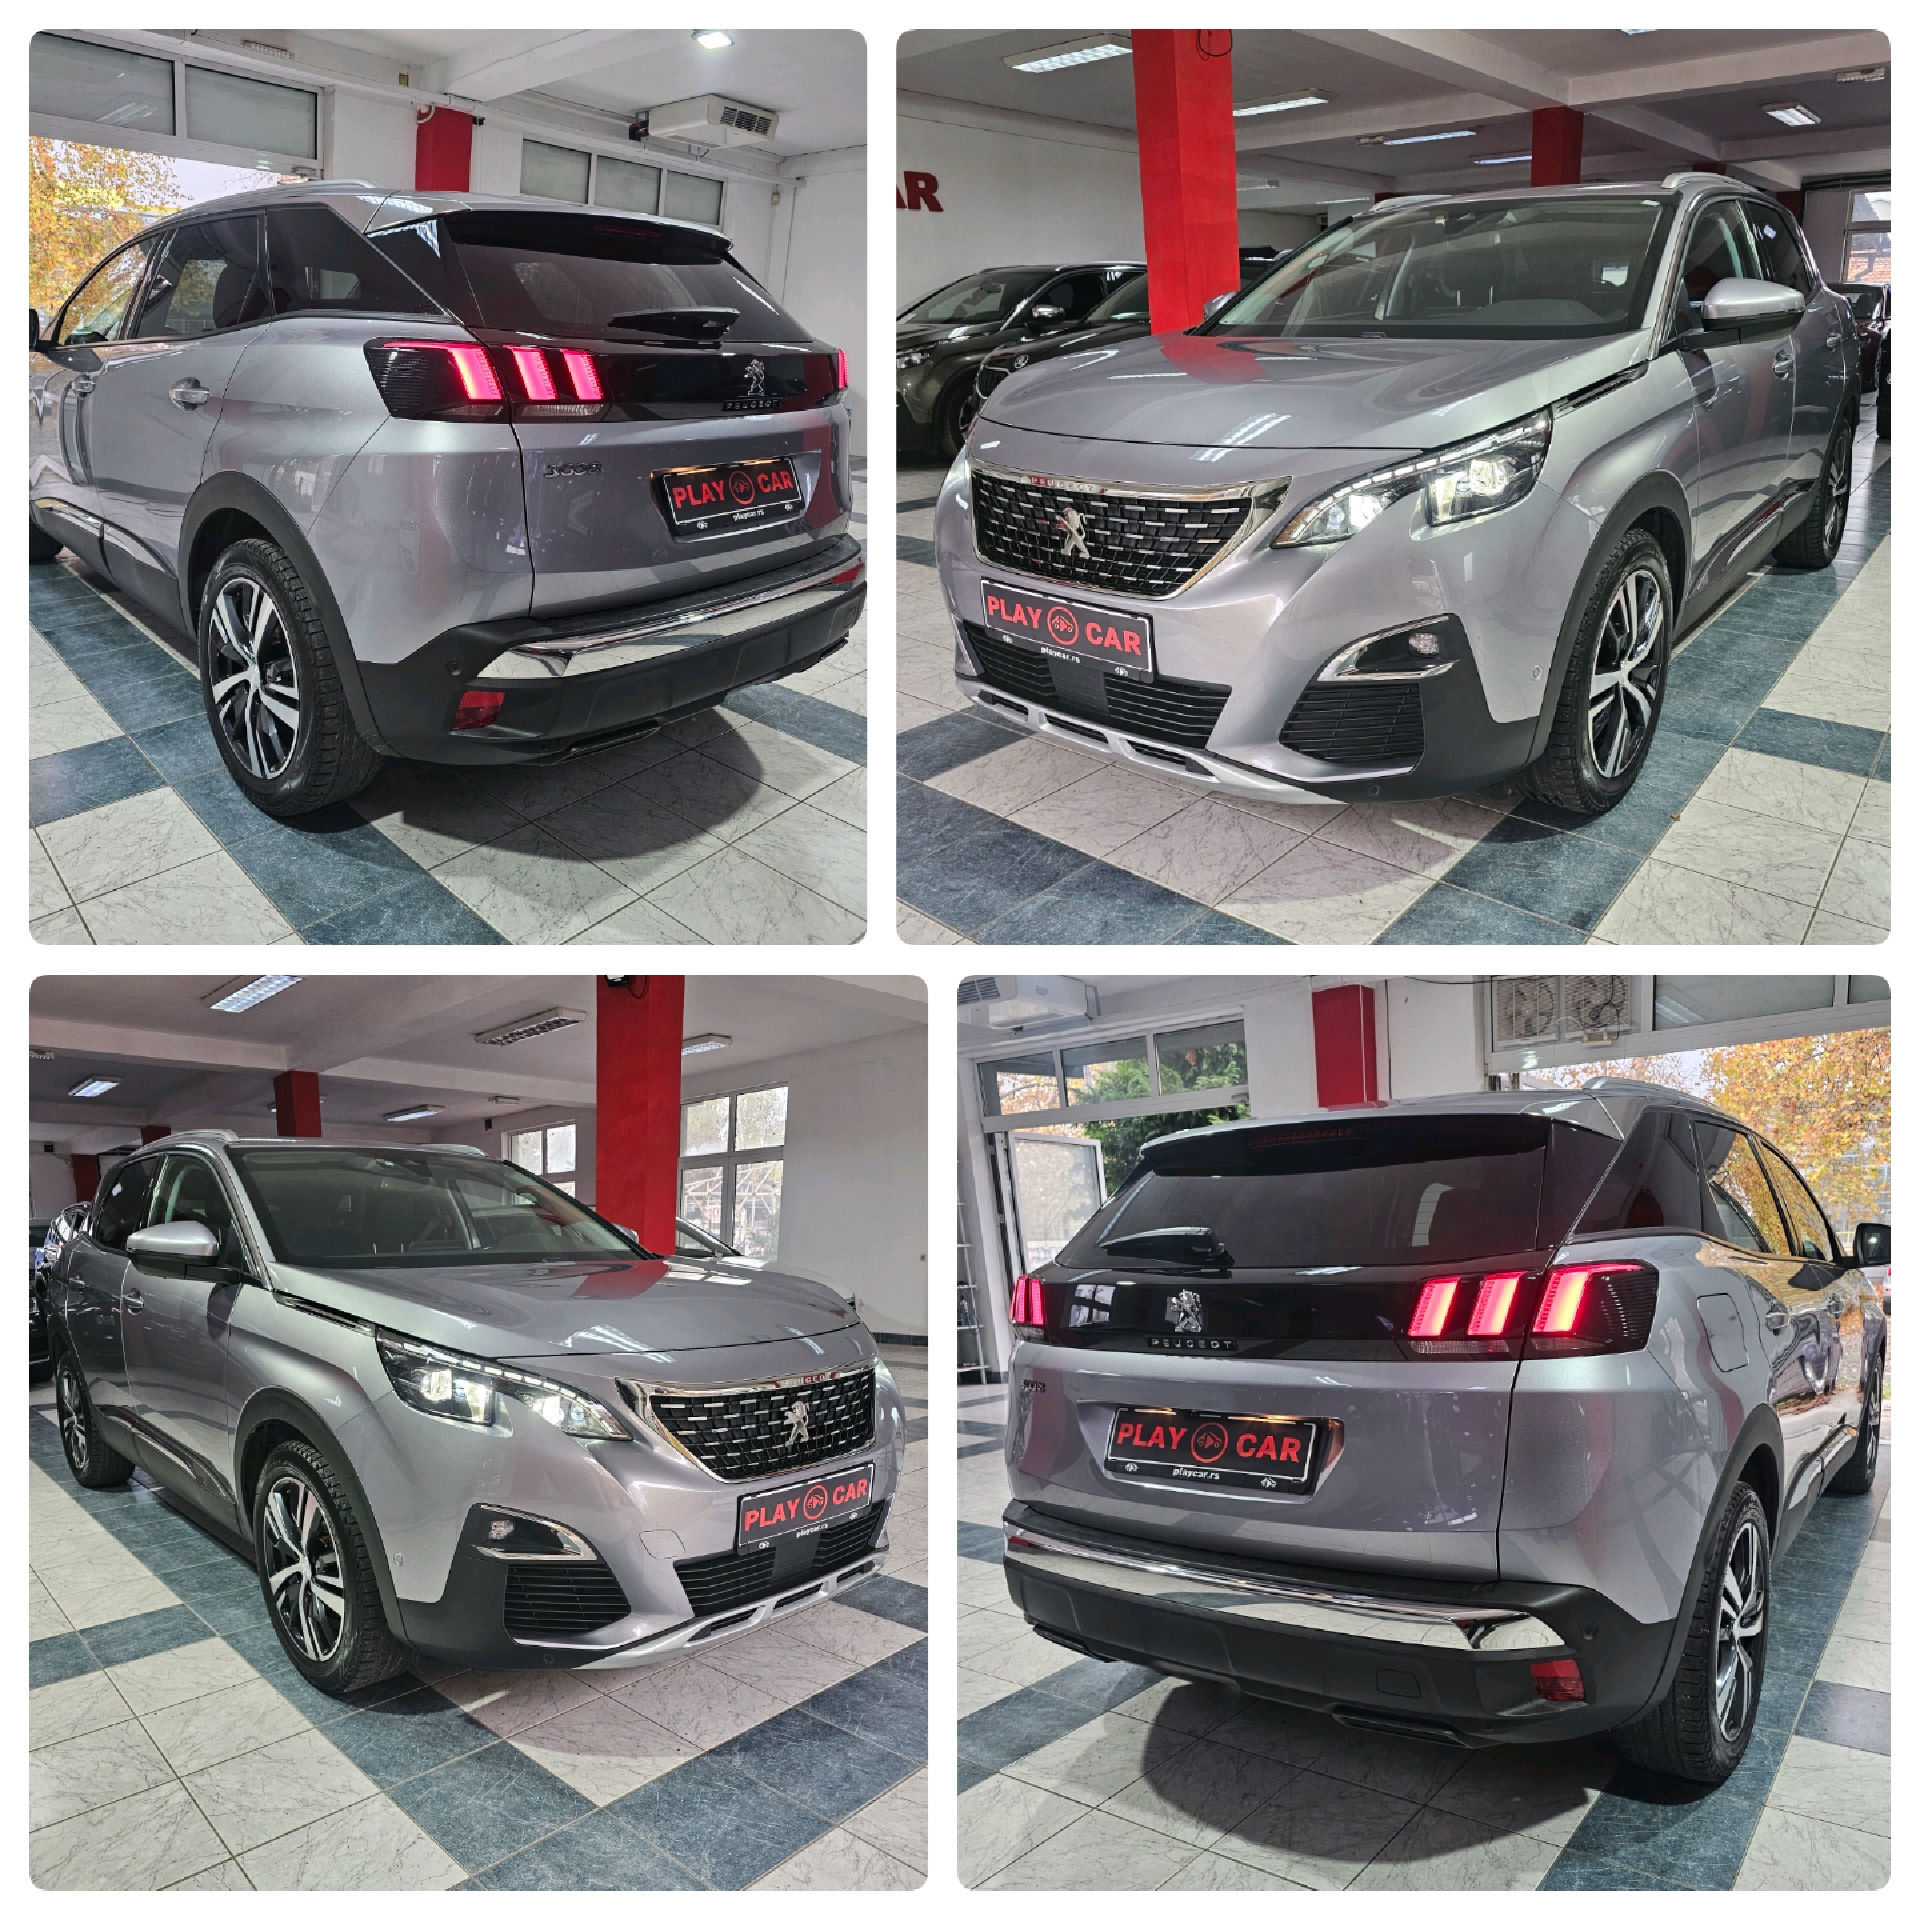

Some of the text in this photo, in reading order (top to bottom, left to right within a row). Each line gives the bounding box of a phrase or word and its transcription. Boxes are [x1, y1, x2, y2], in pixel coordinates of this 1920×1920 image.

[672, 471, 794, 508] PLAY CAR
[986, 595, 1142, 656] PLAY CAR
[1151, 1339, 1232, 1349] PEUGEOT
[1116, 1423, 1302, 1463] PLAY CAR
[1172, 1467, 1220, 1480] playcar.rs
[744, 1479, 868, 1532] PLAY CAR
